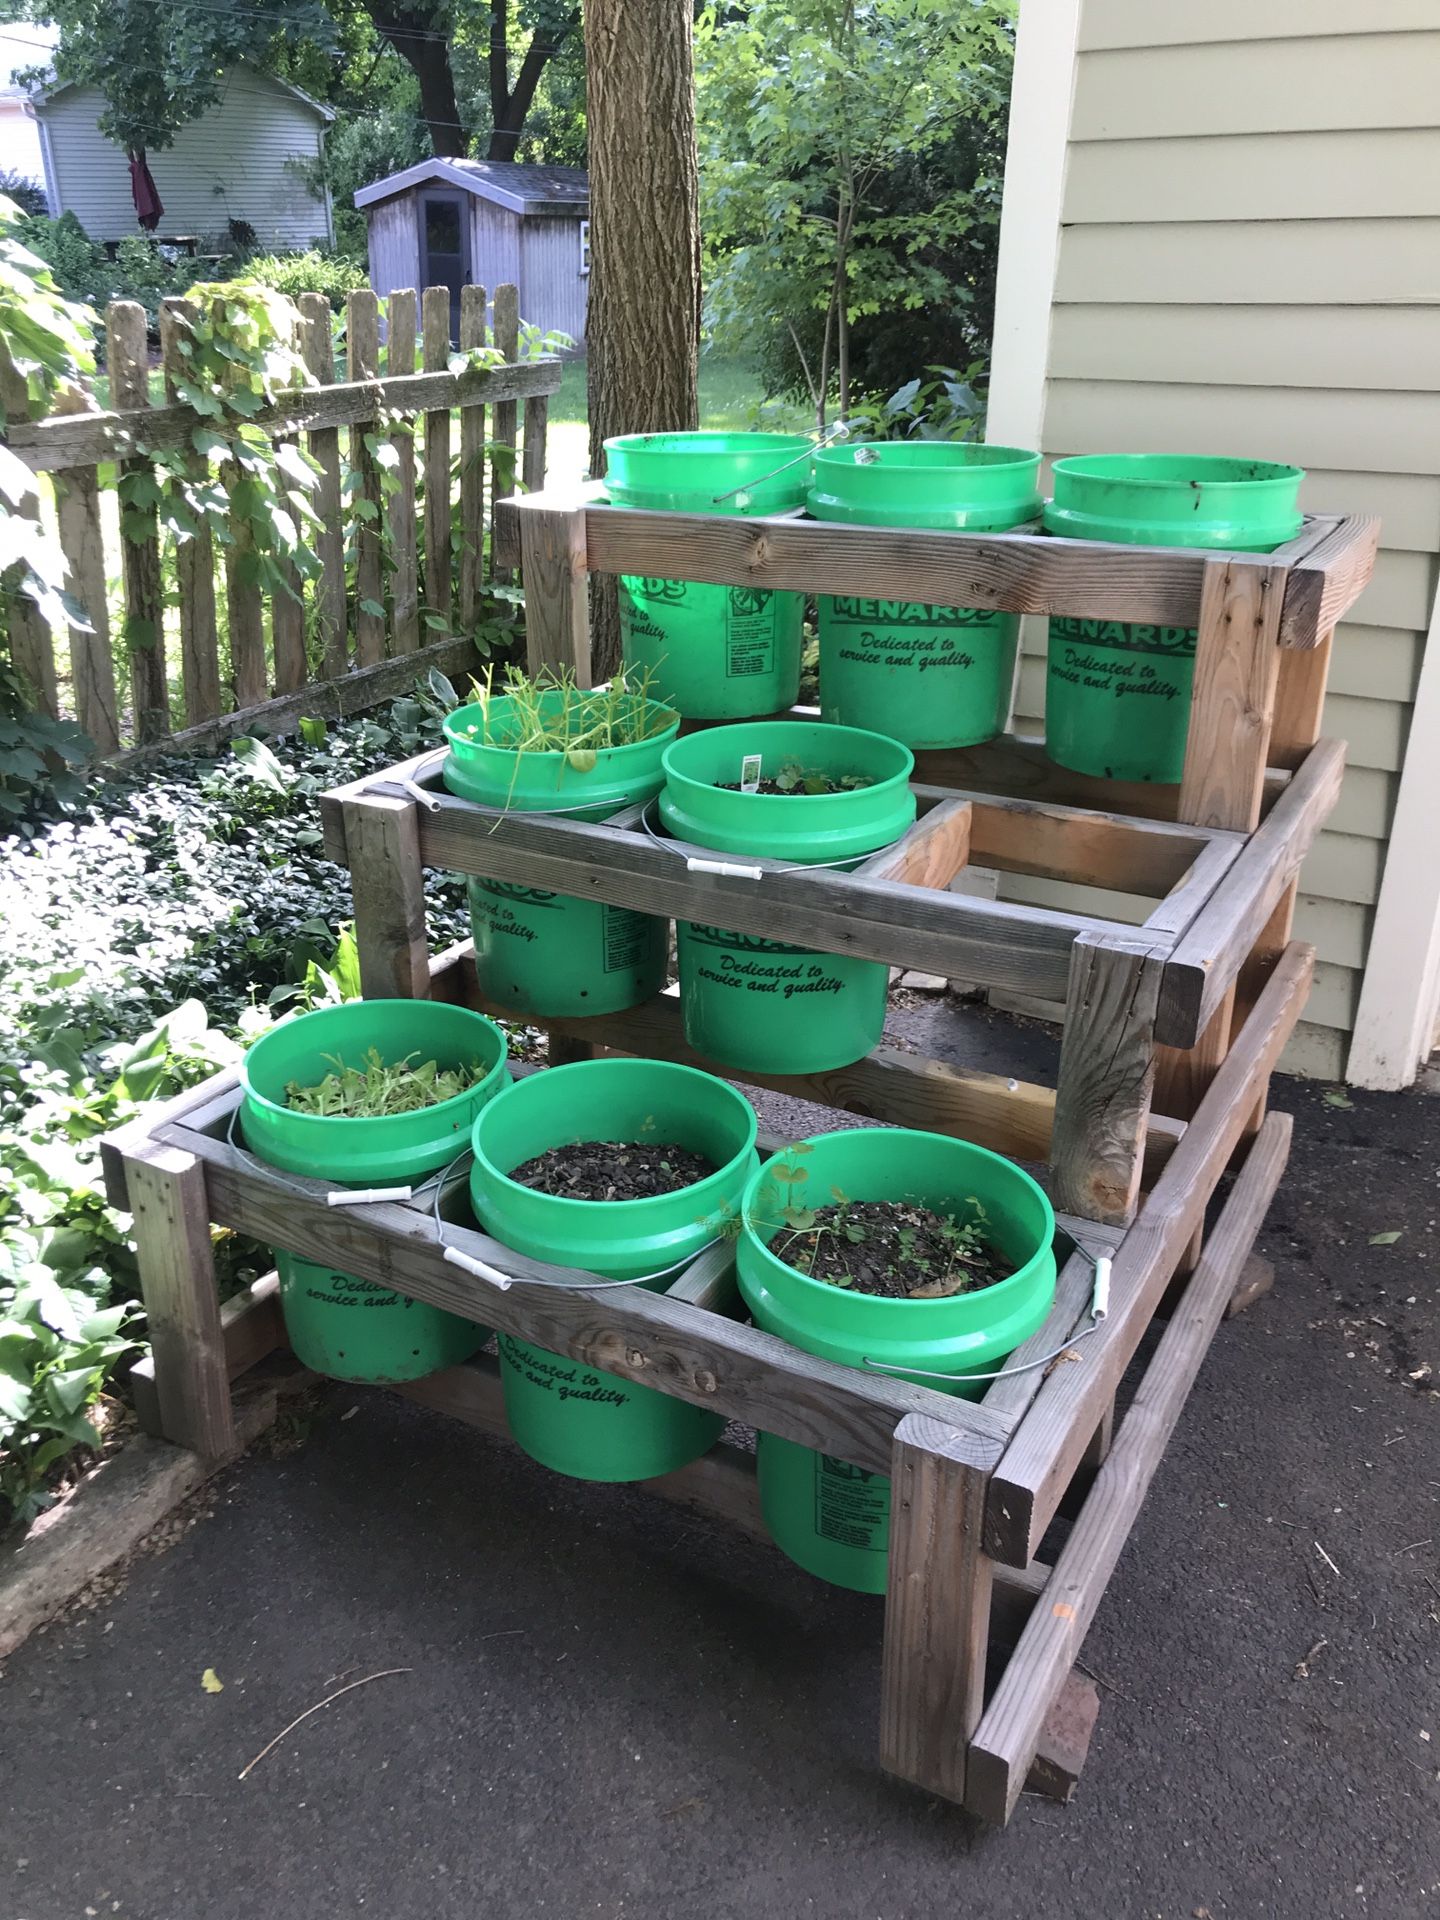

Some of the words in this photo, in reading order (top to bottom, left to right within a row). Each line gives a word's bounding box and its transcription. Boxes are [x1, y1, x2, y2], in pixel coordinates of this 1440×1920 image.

[861, 632, 937, 651] Dedicated
[941, 638, 955, 651] to
[840, 649, 880, 663] service
[885, 652, 914, 666] and
[918, 652, 975, 672] quality.
[1065, 648, 1136, 675] Dedicated
[1140, 665, 1156, 678] to
[1083, 676, 1112, 689] and
[1115, 680, 1181, 700] quality.
[488, 920, 539, 942] quality.
[720, 954, 803, 979] Dedicated
[807, 965, 823, 977] to
[698, 967, 742, 988] service
[747, 979, 779, 993] and
[783, 977, 846, 999] quality.
[306, 1288, 359, 1306] service
[364, 1292, 398, 1306] and
[505, 1334, 576, 1382] Dedicated
[582, 1373, 600, 1387] to
[526, 1371, 554, 1390] and
[558, 1386, 631, 1407] quality.
